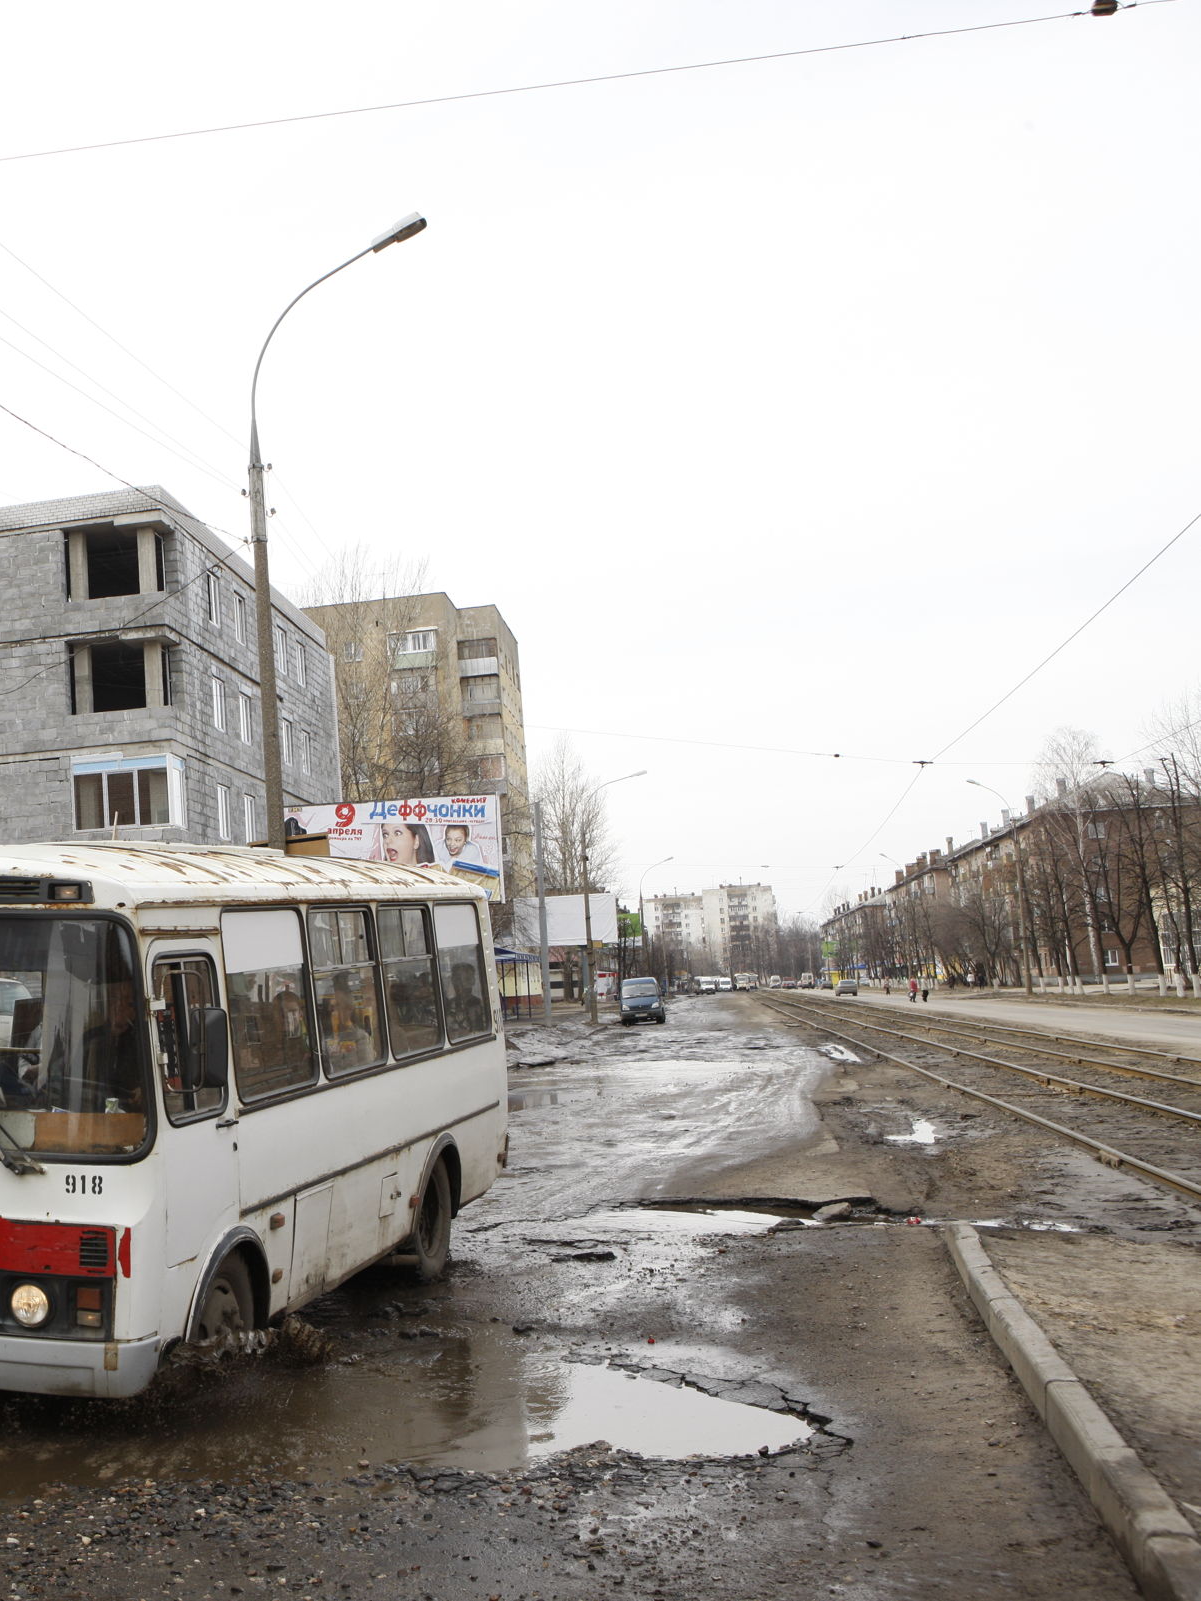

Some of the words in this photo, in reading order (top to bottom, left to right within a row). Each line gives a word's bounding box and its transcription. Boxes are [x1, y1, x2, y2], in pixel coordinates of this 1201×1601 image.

[335, 803, 356, 828] 9
[327, 828, 363, 836] апреля
[65, 1174, 103, 1195] 918
